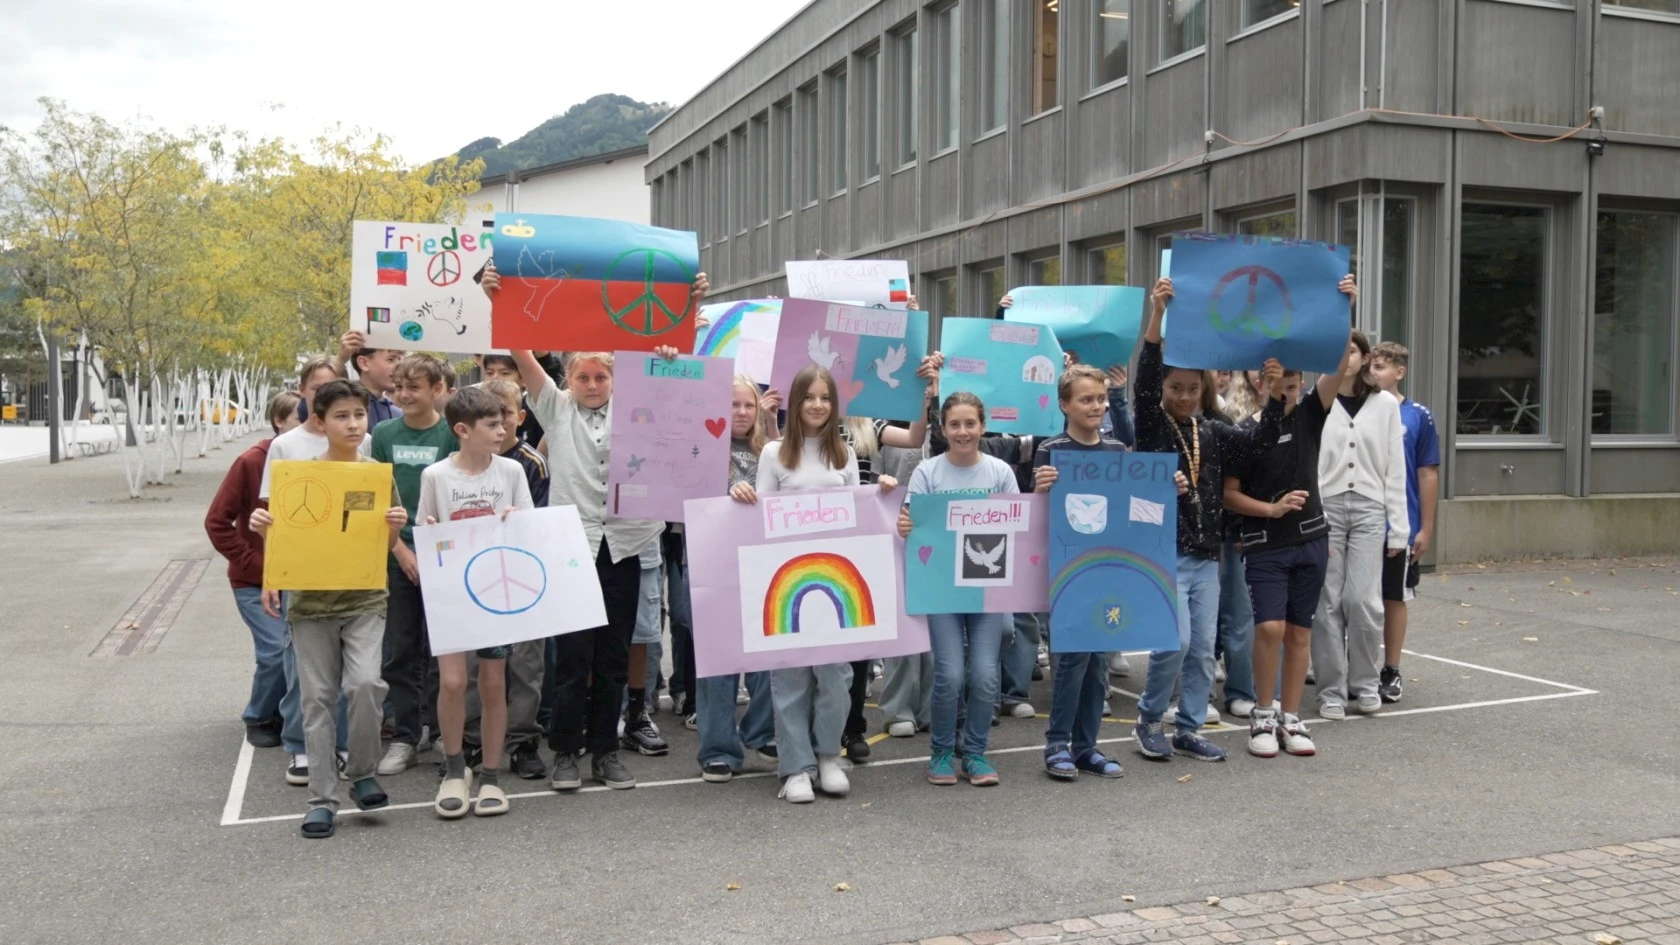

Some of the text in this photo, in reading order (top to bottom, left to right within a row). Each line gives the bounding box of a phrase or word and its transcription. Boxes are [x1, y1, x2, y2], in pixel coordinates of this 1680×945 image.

[385, 227, 494, 255] Frieden
[650, 358, 700, 379] Frieden
[1054, 453, 1168, 483] Frieden
[452, 489, 478, 502] Italian
[766, 497, 850, 531] Frieden
[949, 503, 1022, 527] Frieden!!!
